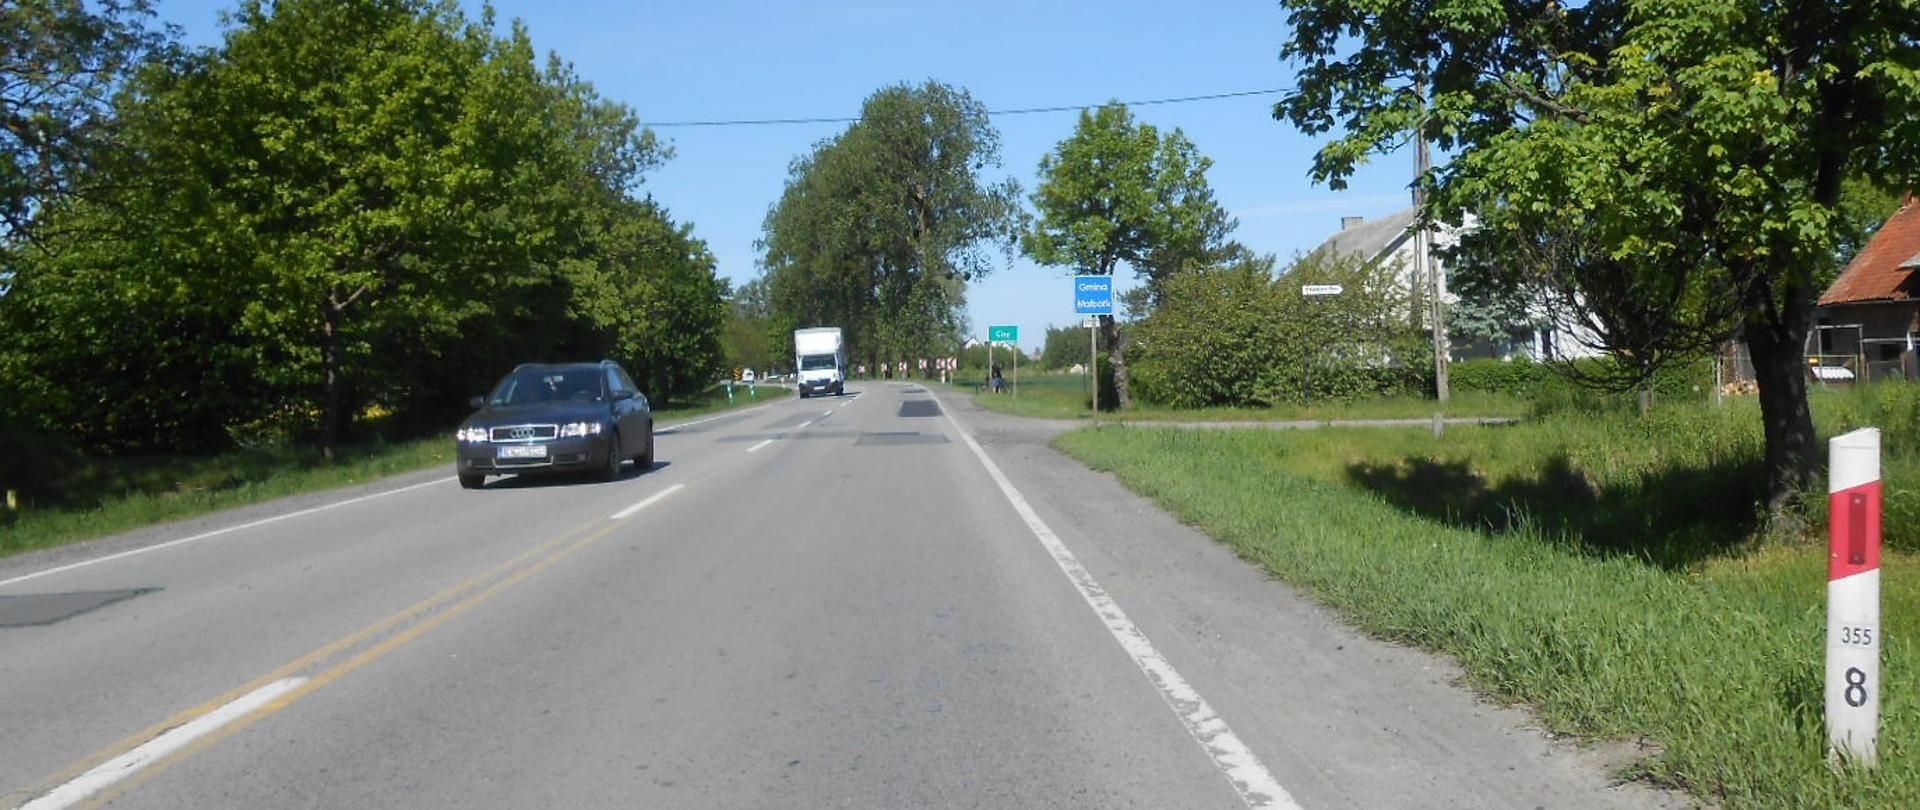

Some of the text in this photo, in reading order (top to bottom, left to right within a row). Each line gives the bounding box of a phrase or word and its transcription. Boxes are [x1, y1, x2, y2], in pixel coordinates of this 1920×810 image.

[1079, 283, 1108, 291] Gmina
[1841, 626, 1872, 645] 355
[1845, 667, 1867, 707] 8
